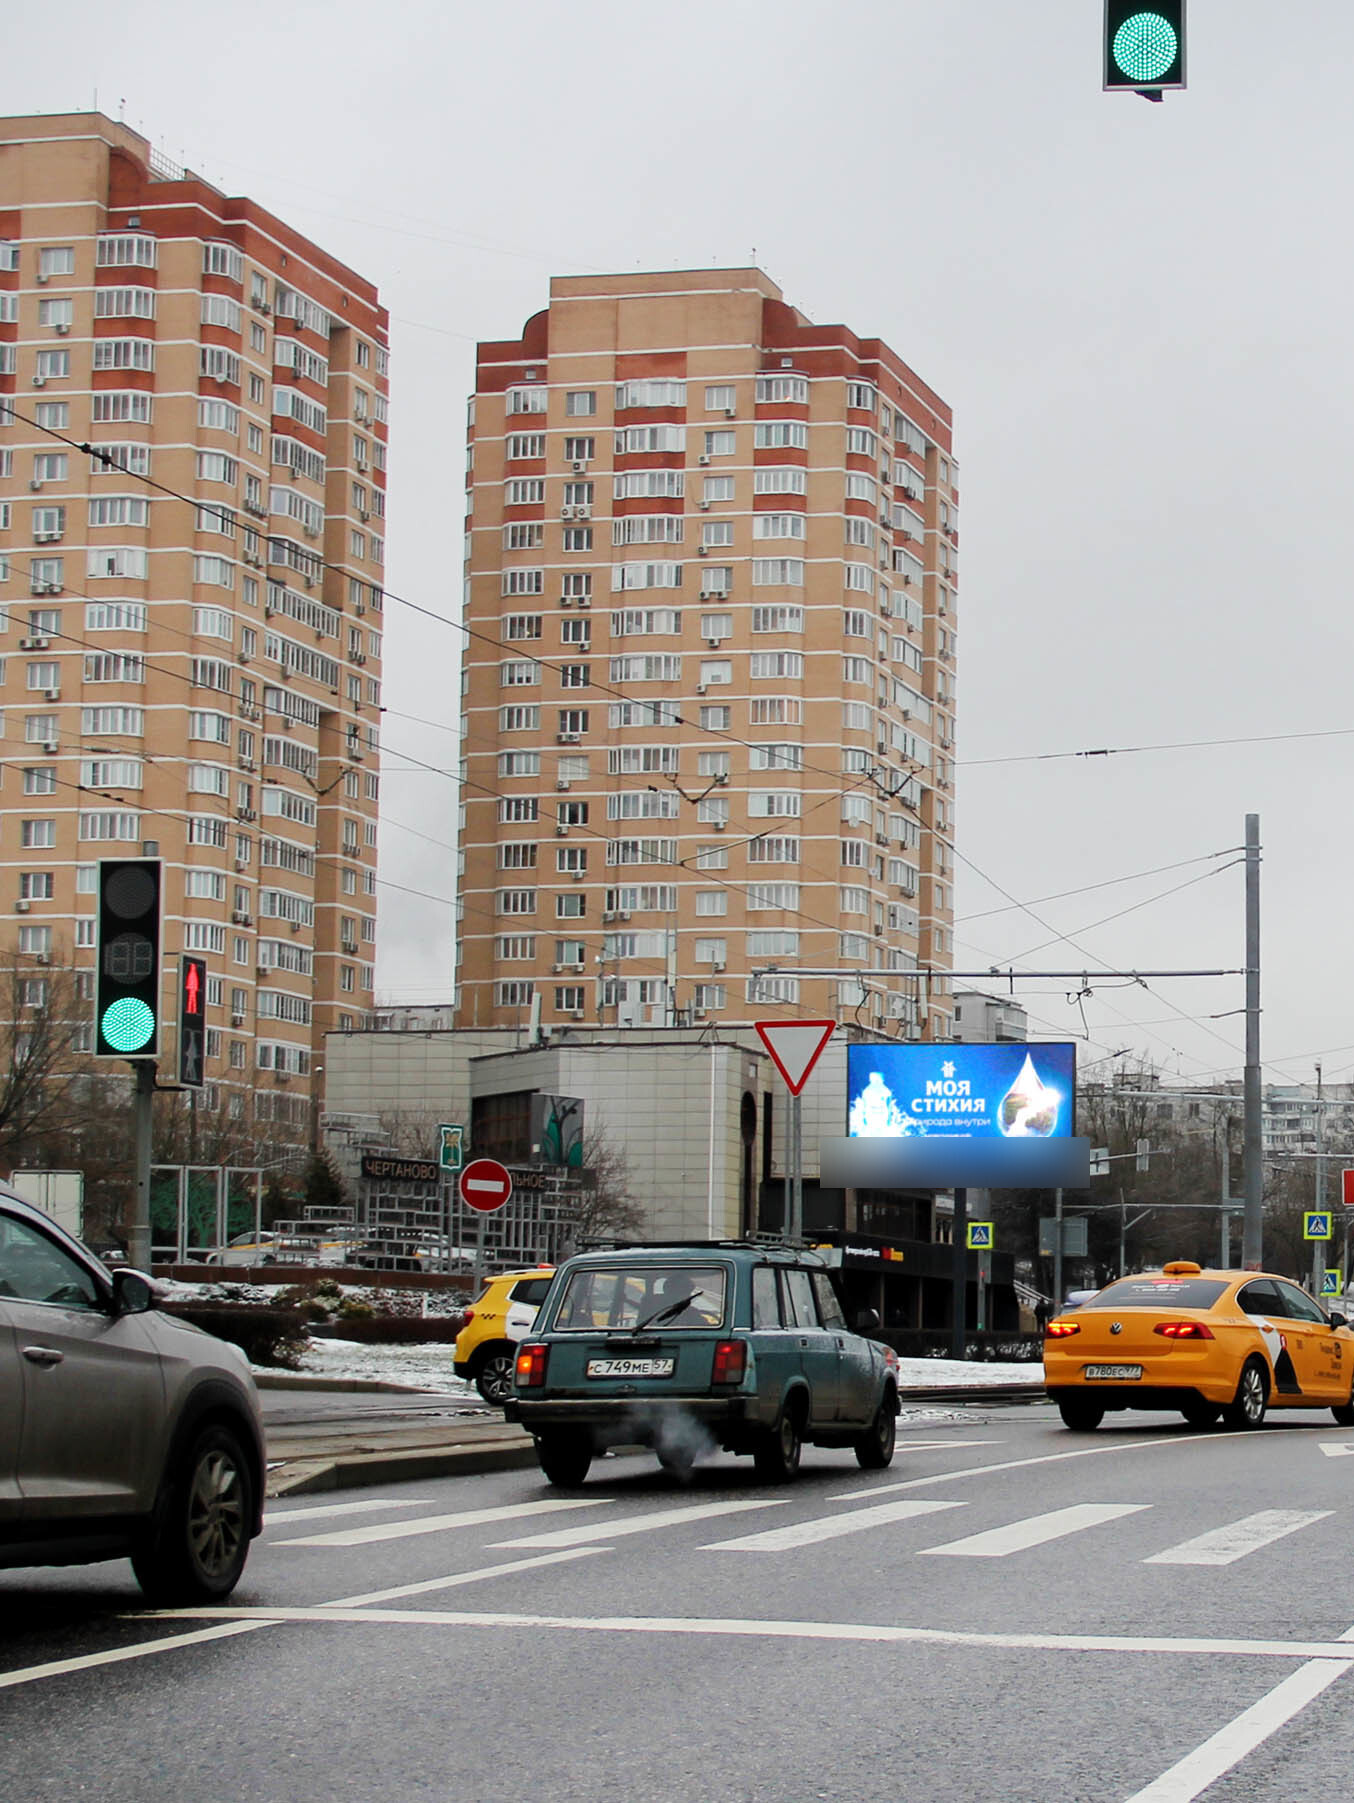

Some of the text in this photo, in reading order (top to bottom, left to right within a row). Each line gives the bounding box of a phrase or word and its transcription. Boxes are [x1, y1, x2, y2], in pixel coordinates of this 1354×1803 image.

[926, 1080, 971, 1096] МОЯ
[911, 1098, 986, 1113] СТИХИЯ
[366, 1160, 437, 1180] ЧЕРТАНОВО
